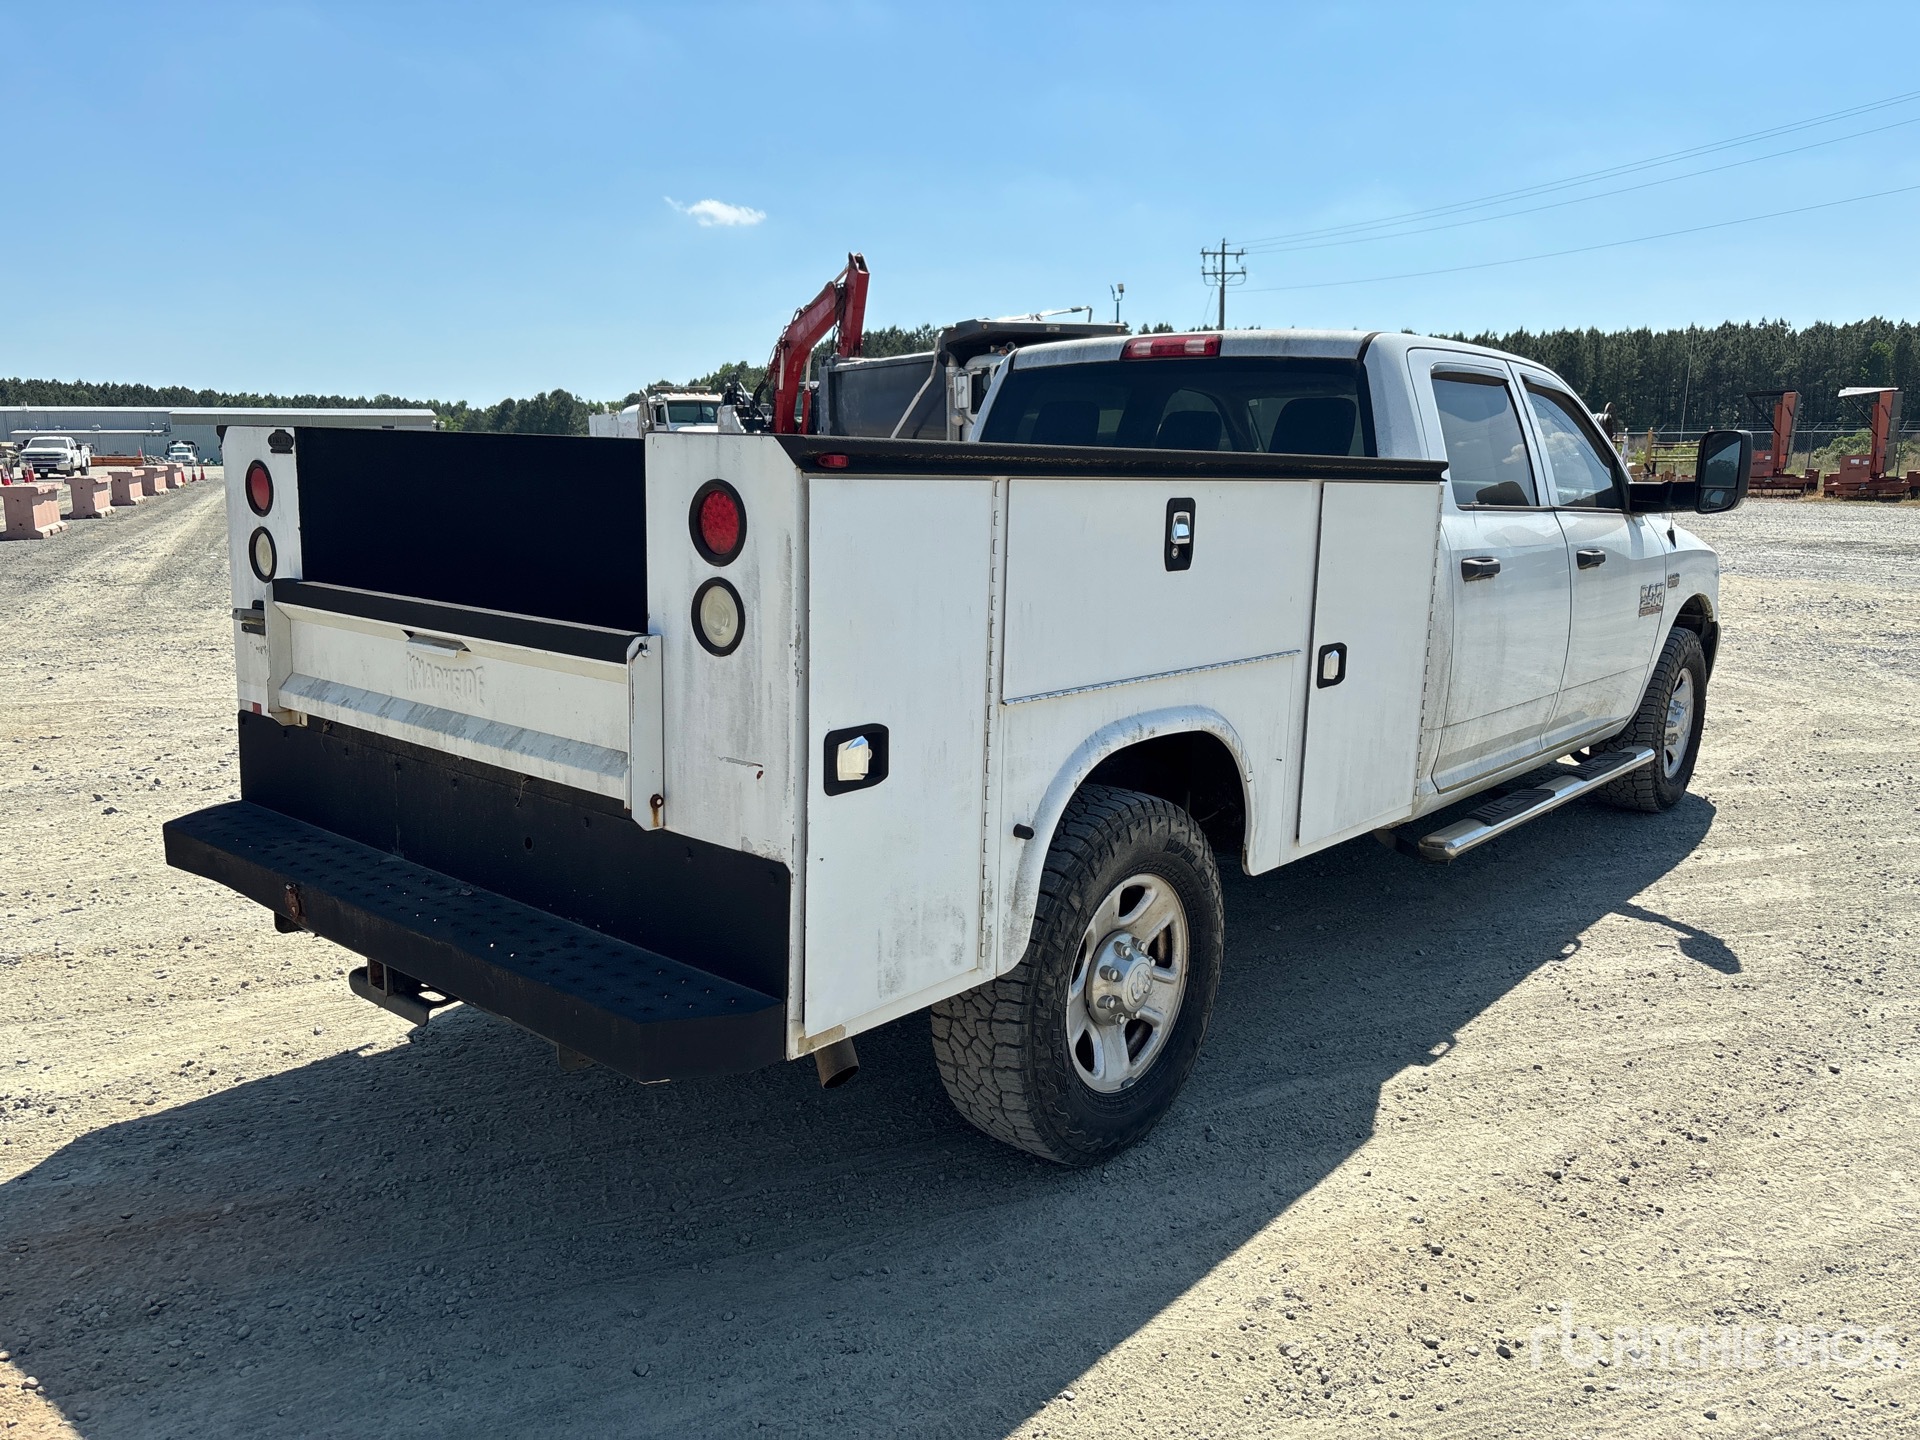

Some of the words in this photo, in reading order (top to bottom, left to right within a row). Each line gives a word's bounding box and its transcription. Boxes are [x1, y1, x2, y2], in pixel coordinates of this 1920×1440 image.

[1641, 582, 1665, 598] RAM
[1640, 595, 1664, 609] 2500
[406, 650, 485, 708] KNAPHEIDE
